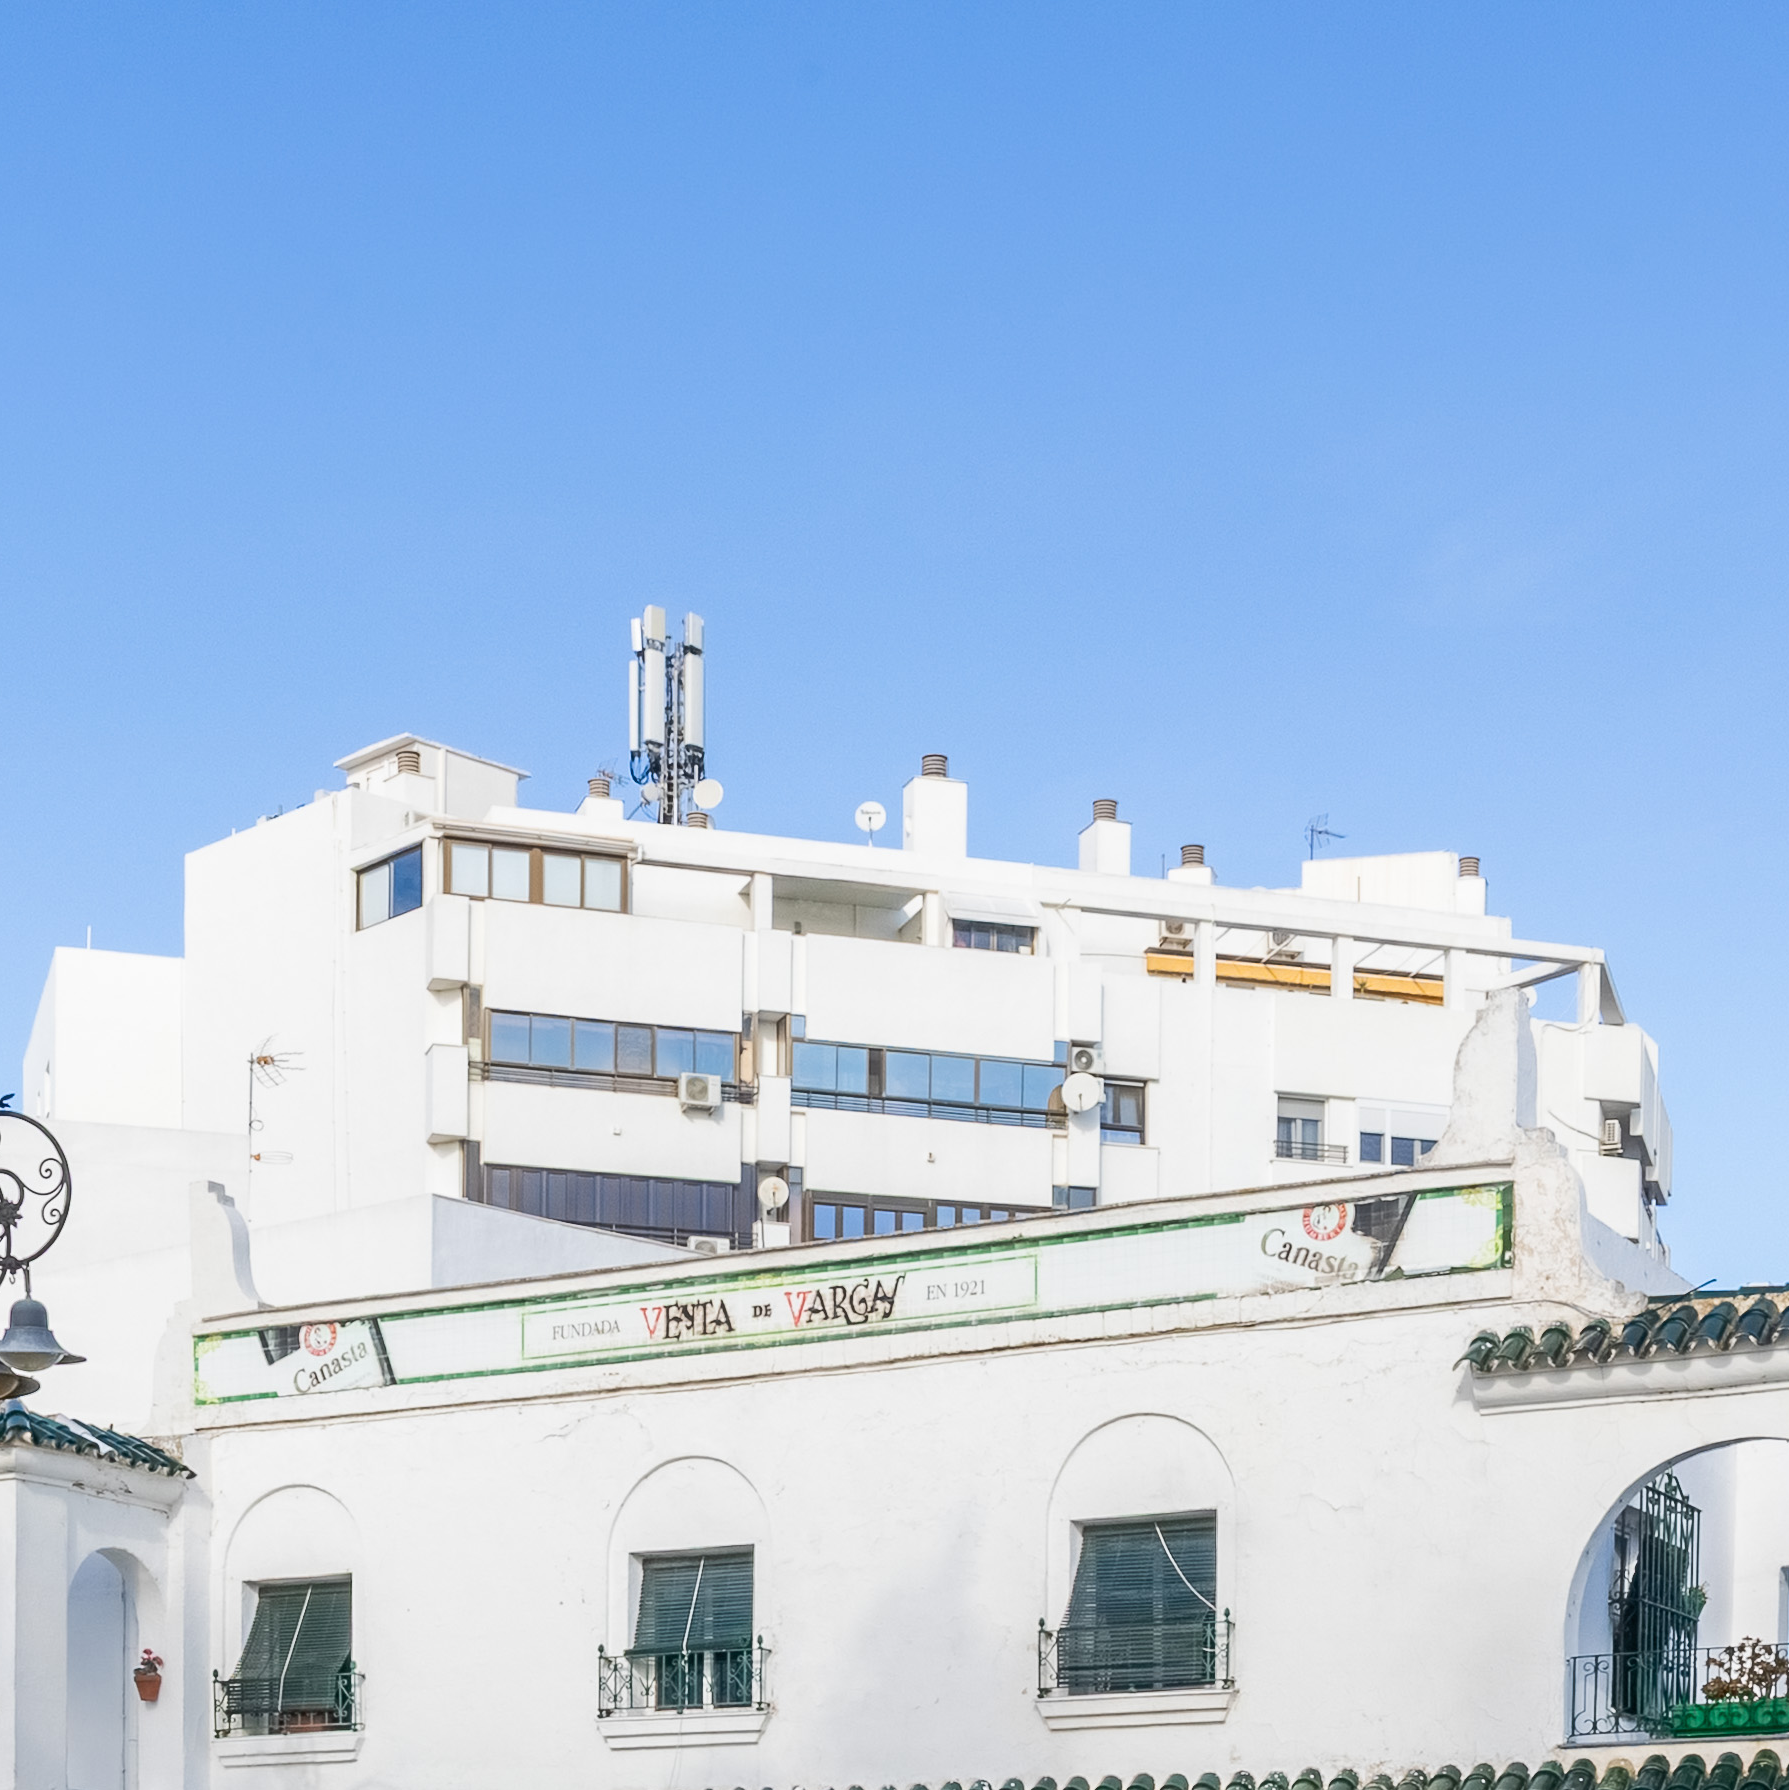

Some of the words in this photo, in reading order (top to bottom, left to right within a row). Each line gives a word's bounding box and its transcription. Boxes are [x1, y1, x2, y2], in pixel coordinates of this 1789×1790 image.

[1260, 1228, 1359, 1281] Canasta
[552, 1319, 621, 1341] FUNDADA
[640, 1299, 736, 1342] VENTA
[752, 1304, 772, 1318] DE
[784, 1273, 907, 1327] VARGAS
[926, 1284, 948, 1301] EN
[954, 1279, 987, 1298] 1921
[293, 1341, 368, 1394] Canasta
